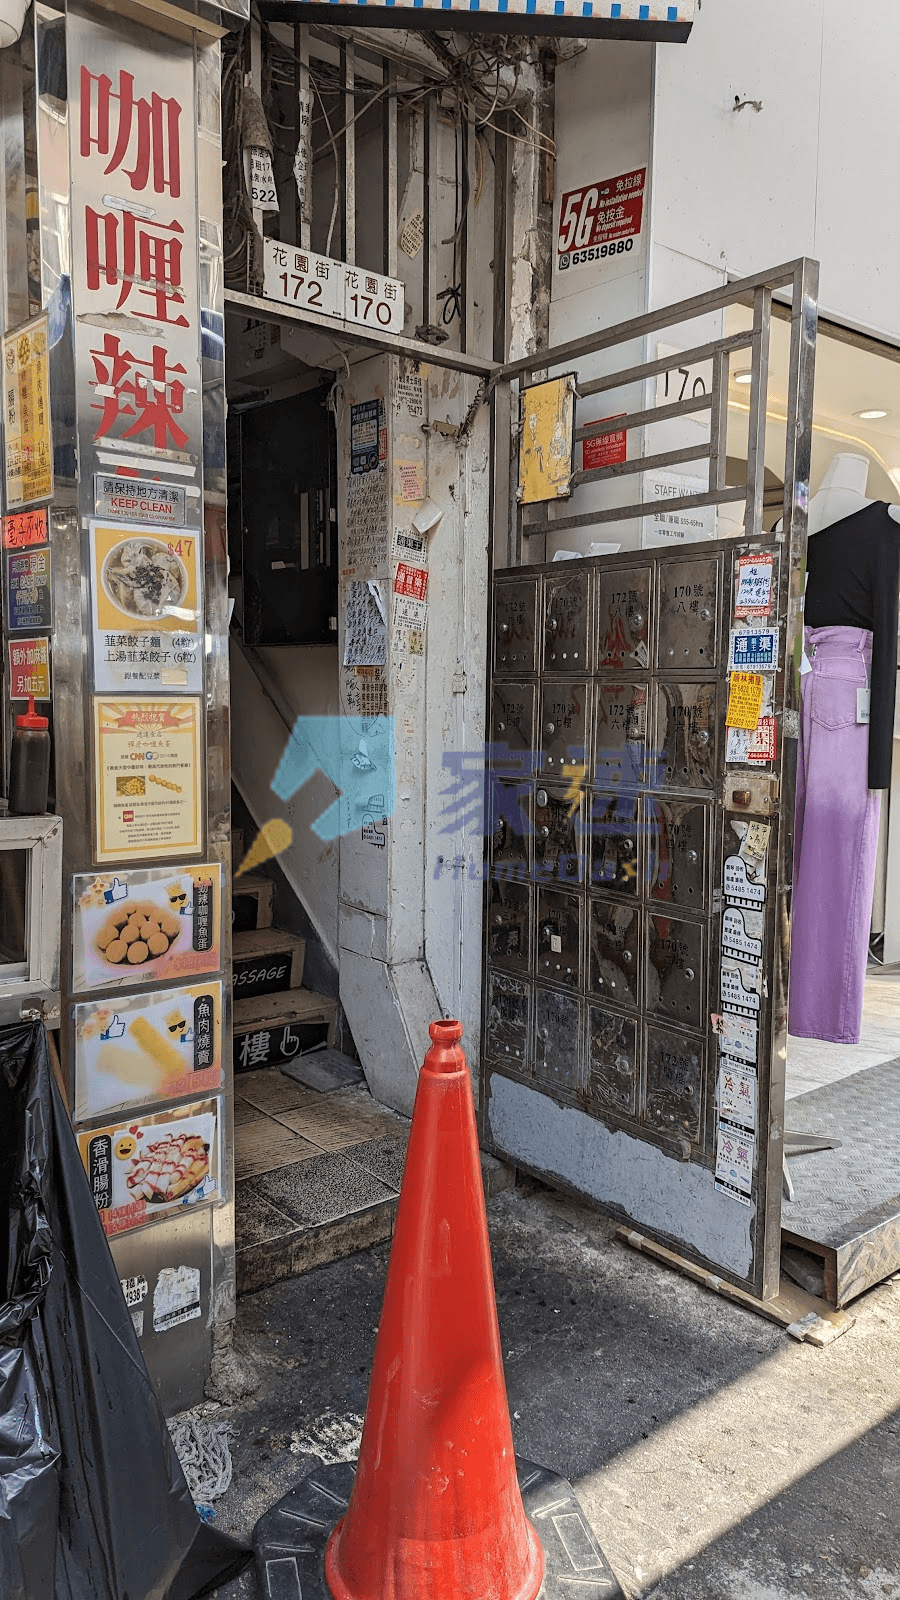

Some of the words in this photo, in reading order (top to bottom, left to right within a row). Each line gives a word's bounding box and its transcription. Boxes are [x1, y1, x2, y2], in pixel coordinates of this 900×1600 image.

[616, 174, 642, 192] 免拉線
[558, 187, 599, 252] 5G
[597, 206, 625, 224] 免按金
[572, 239, 634, 264] 63519880
[273, 246, 330, 280] 花園街
[279, 272, 323, 307] 172
[345, 269, 398, 301] 花園街
[350, 293, 393, 326] 170
[103, 480, 179, 502] 請保持地方清潔
[654, 484, 677, 497] STAFF
[111, 498, 138, 508] KEEP
[140, 501, 172, 514] CLEAN
[167, 539, 193, 557] $47
[611, 590, 638, 604] 172號
[673, 584, 704, 599] 170號
[676, 600, 701, 616] 八樓
[736, 637, 748, 652] 通
[759, 636, 771, 652] 渠
[173, 652, 197, 664] (6粒)
[746, 887, 761, 896] 1474
[743, 940, 758, 950] 1474
[232, 965, 287, 985] ASSAGE
[742, 994, 756, 1004] 1474
[197, 1002, 211, 1065] 魚肉燒賣
[239, 1031, 271, 1067] 樓
[92, 1138, 109, 1209] 香滑腸粉
